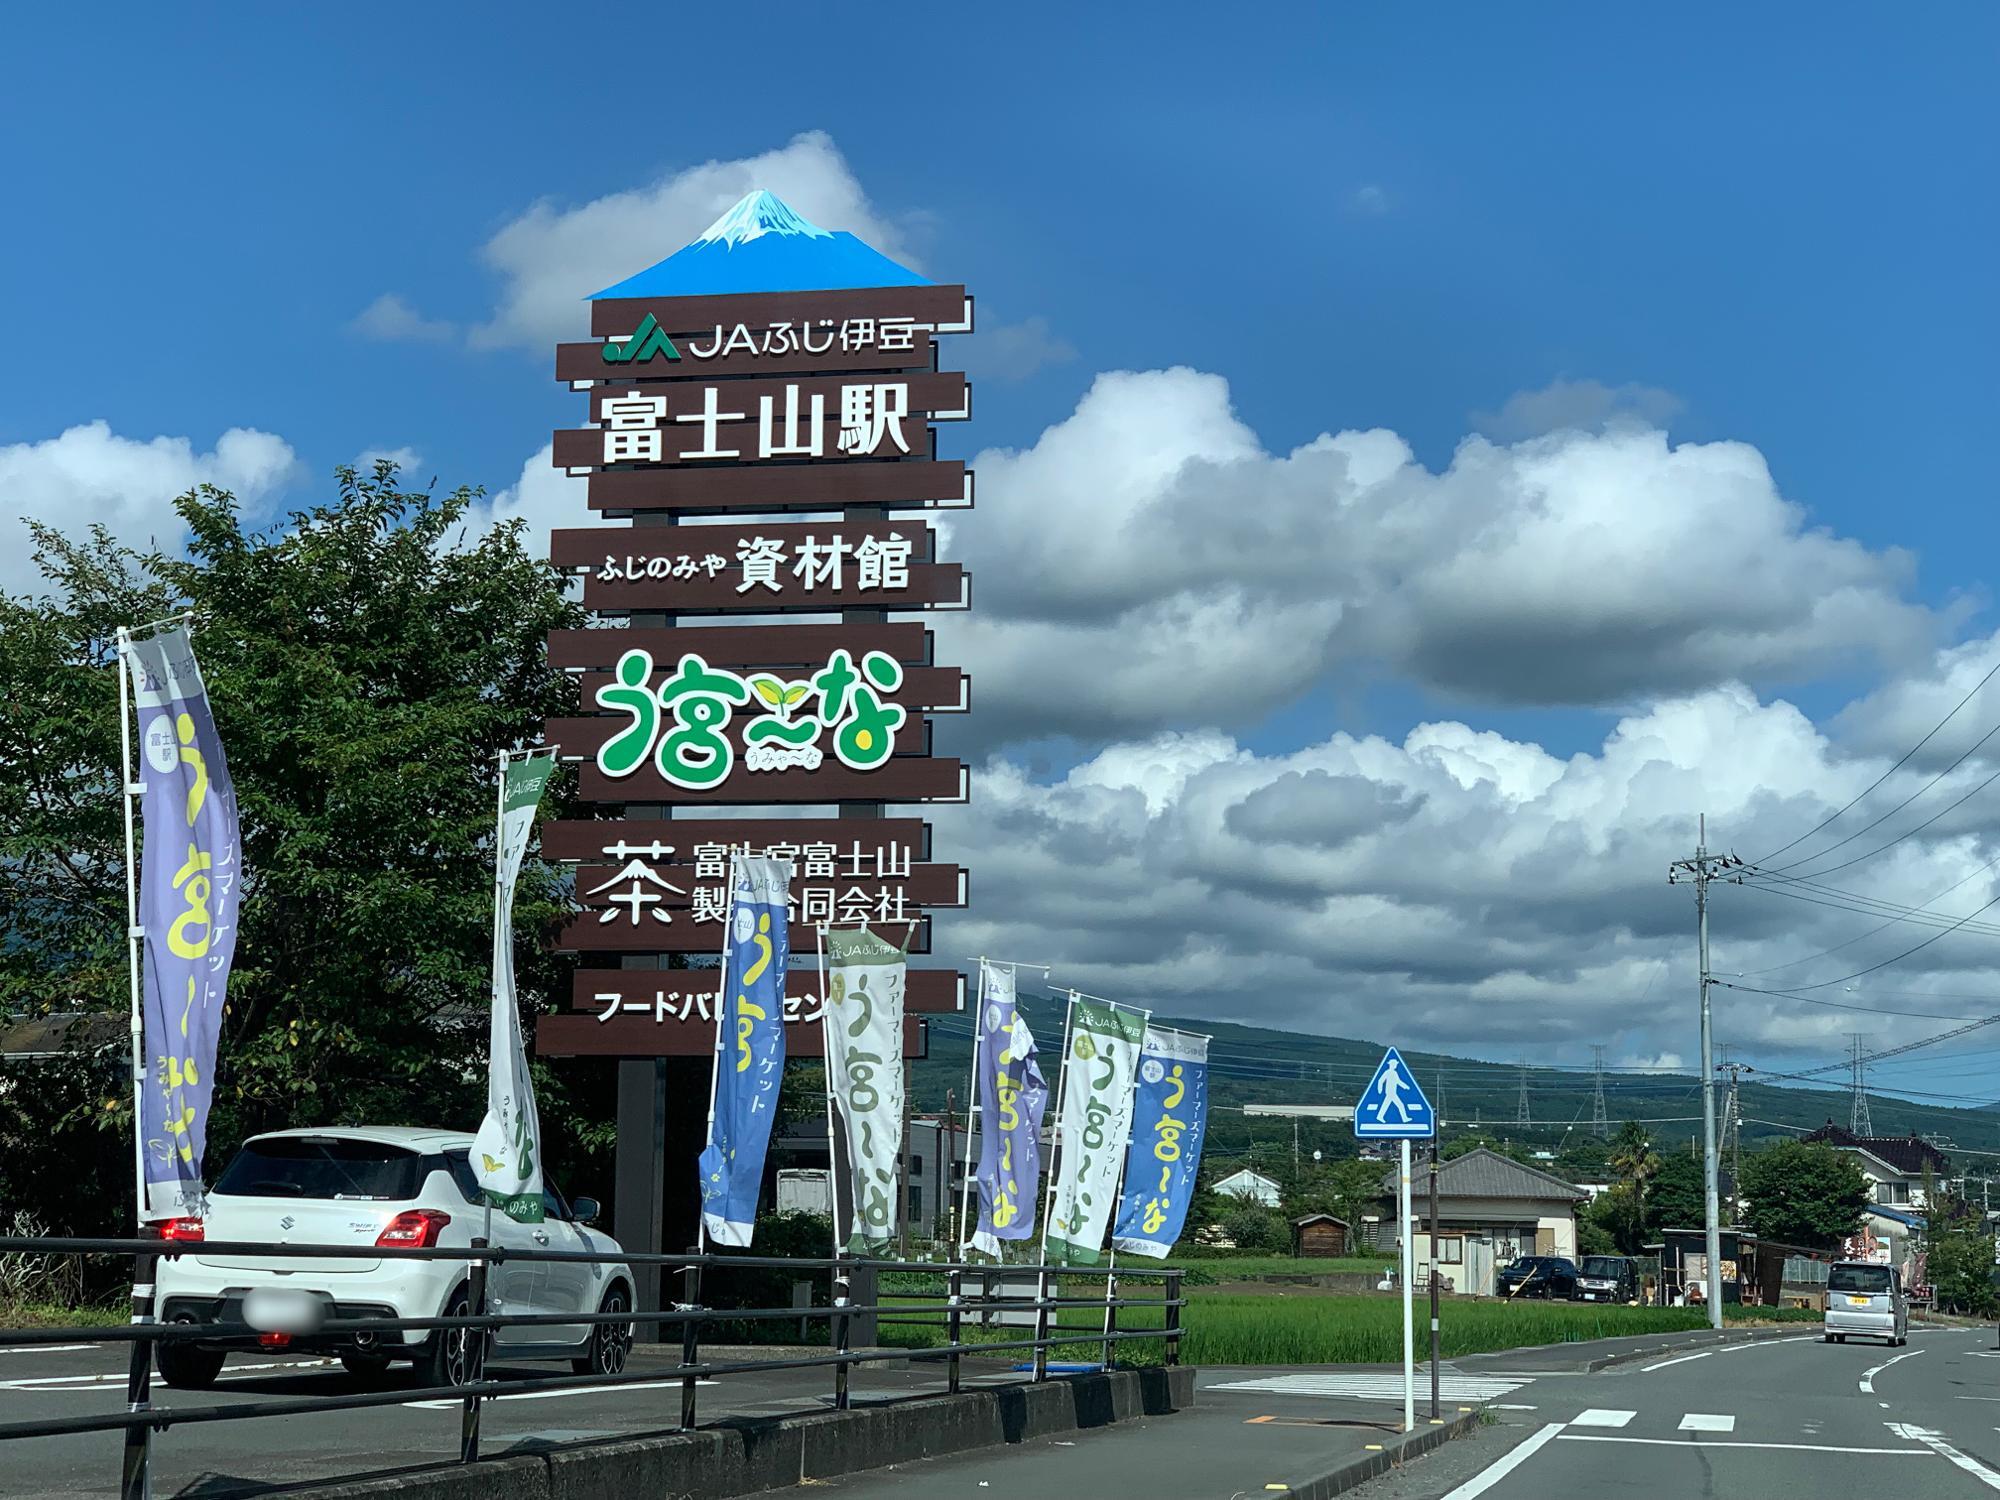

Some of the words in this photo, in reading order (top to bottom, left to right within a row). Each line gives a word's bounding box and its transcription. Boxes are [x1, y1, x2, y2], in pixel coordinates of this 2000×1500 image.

[689, 317, 915, 358] JAふじ伊豆
[601, 383, 911, 463] 富士山駅
[597, 553, 728, 582] ふじのみや
[735, 532, 912, 593] 資材館
[586, 839, 687, 925] 茶
